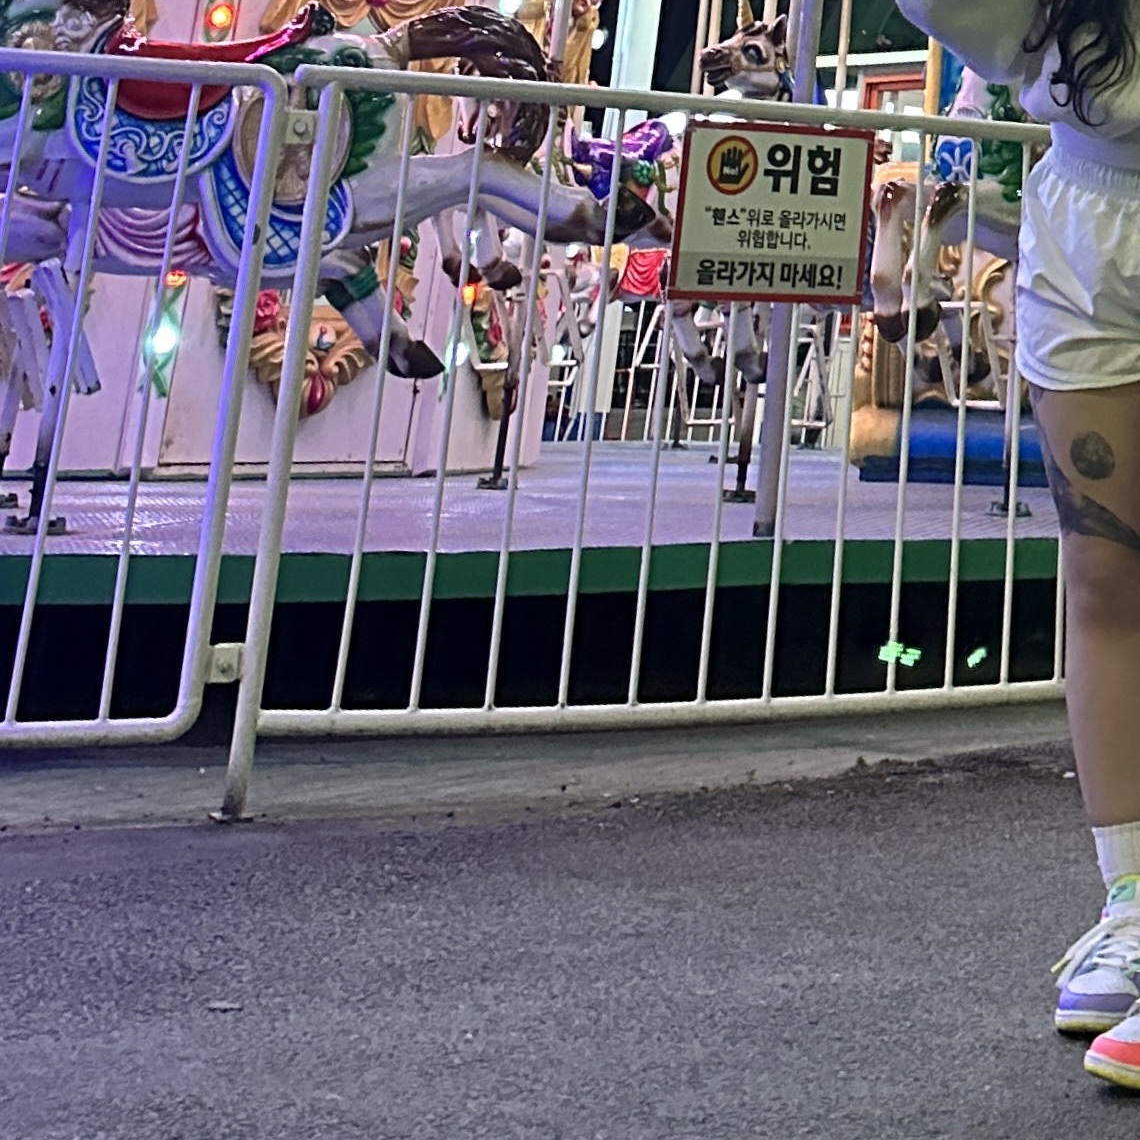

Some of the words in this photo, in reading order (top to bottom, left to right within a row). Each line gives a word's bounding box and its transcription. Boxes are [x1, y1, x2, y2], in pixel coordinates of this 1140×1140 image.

[763, 143, 842, 196] 위험
[778, 209, 846, 232] 올라가시면
[736, 229, 811, 250] 위험합니다.
[696, 259, 775, 288] 올라가지
[779, 262, 843, 290] 마세요!
